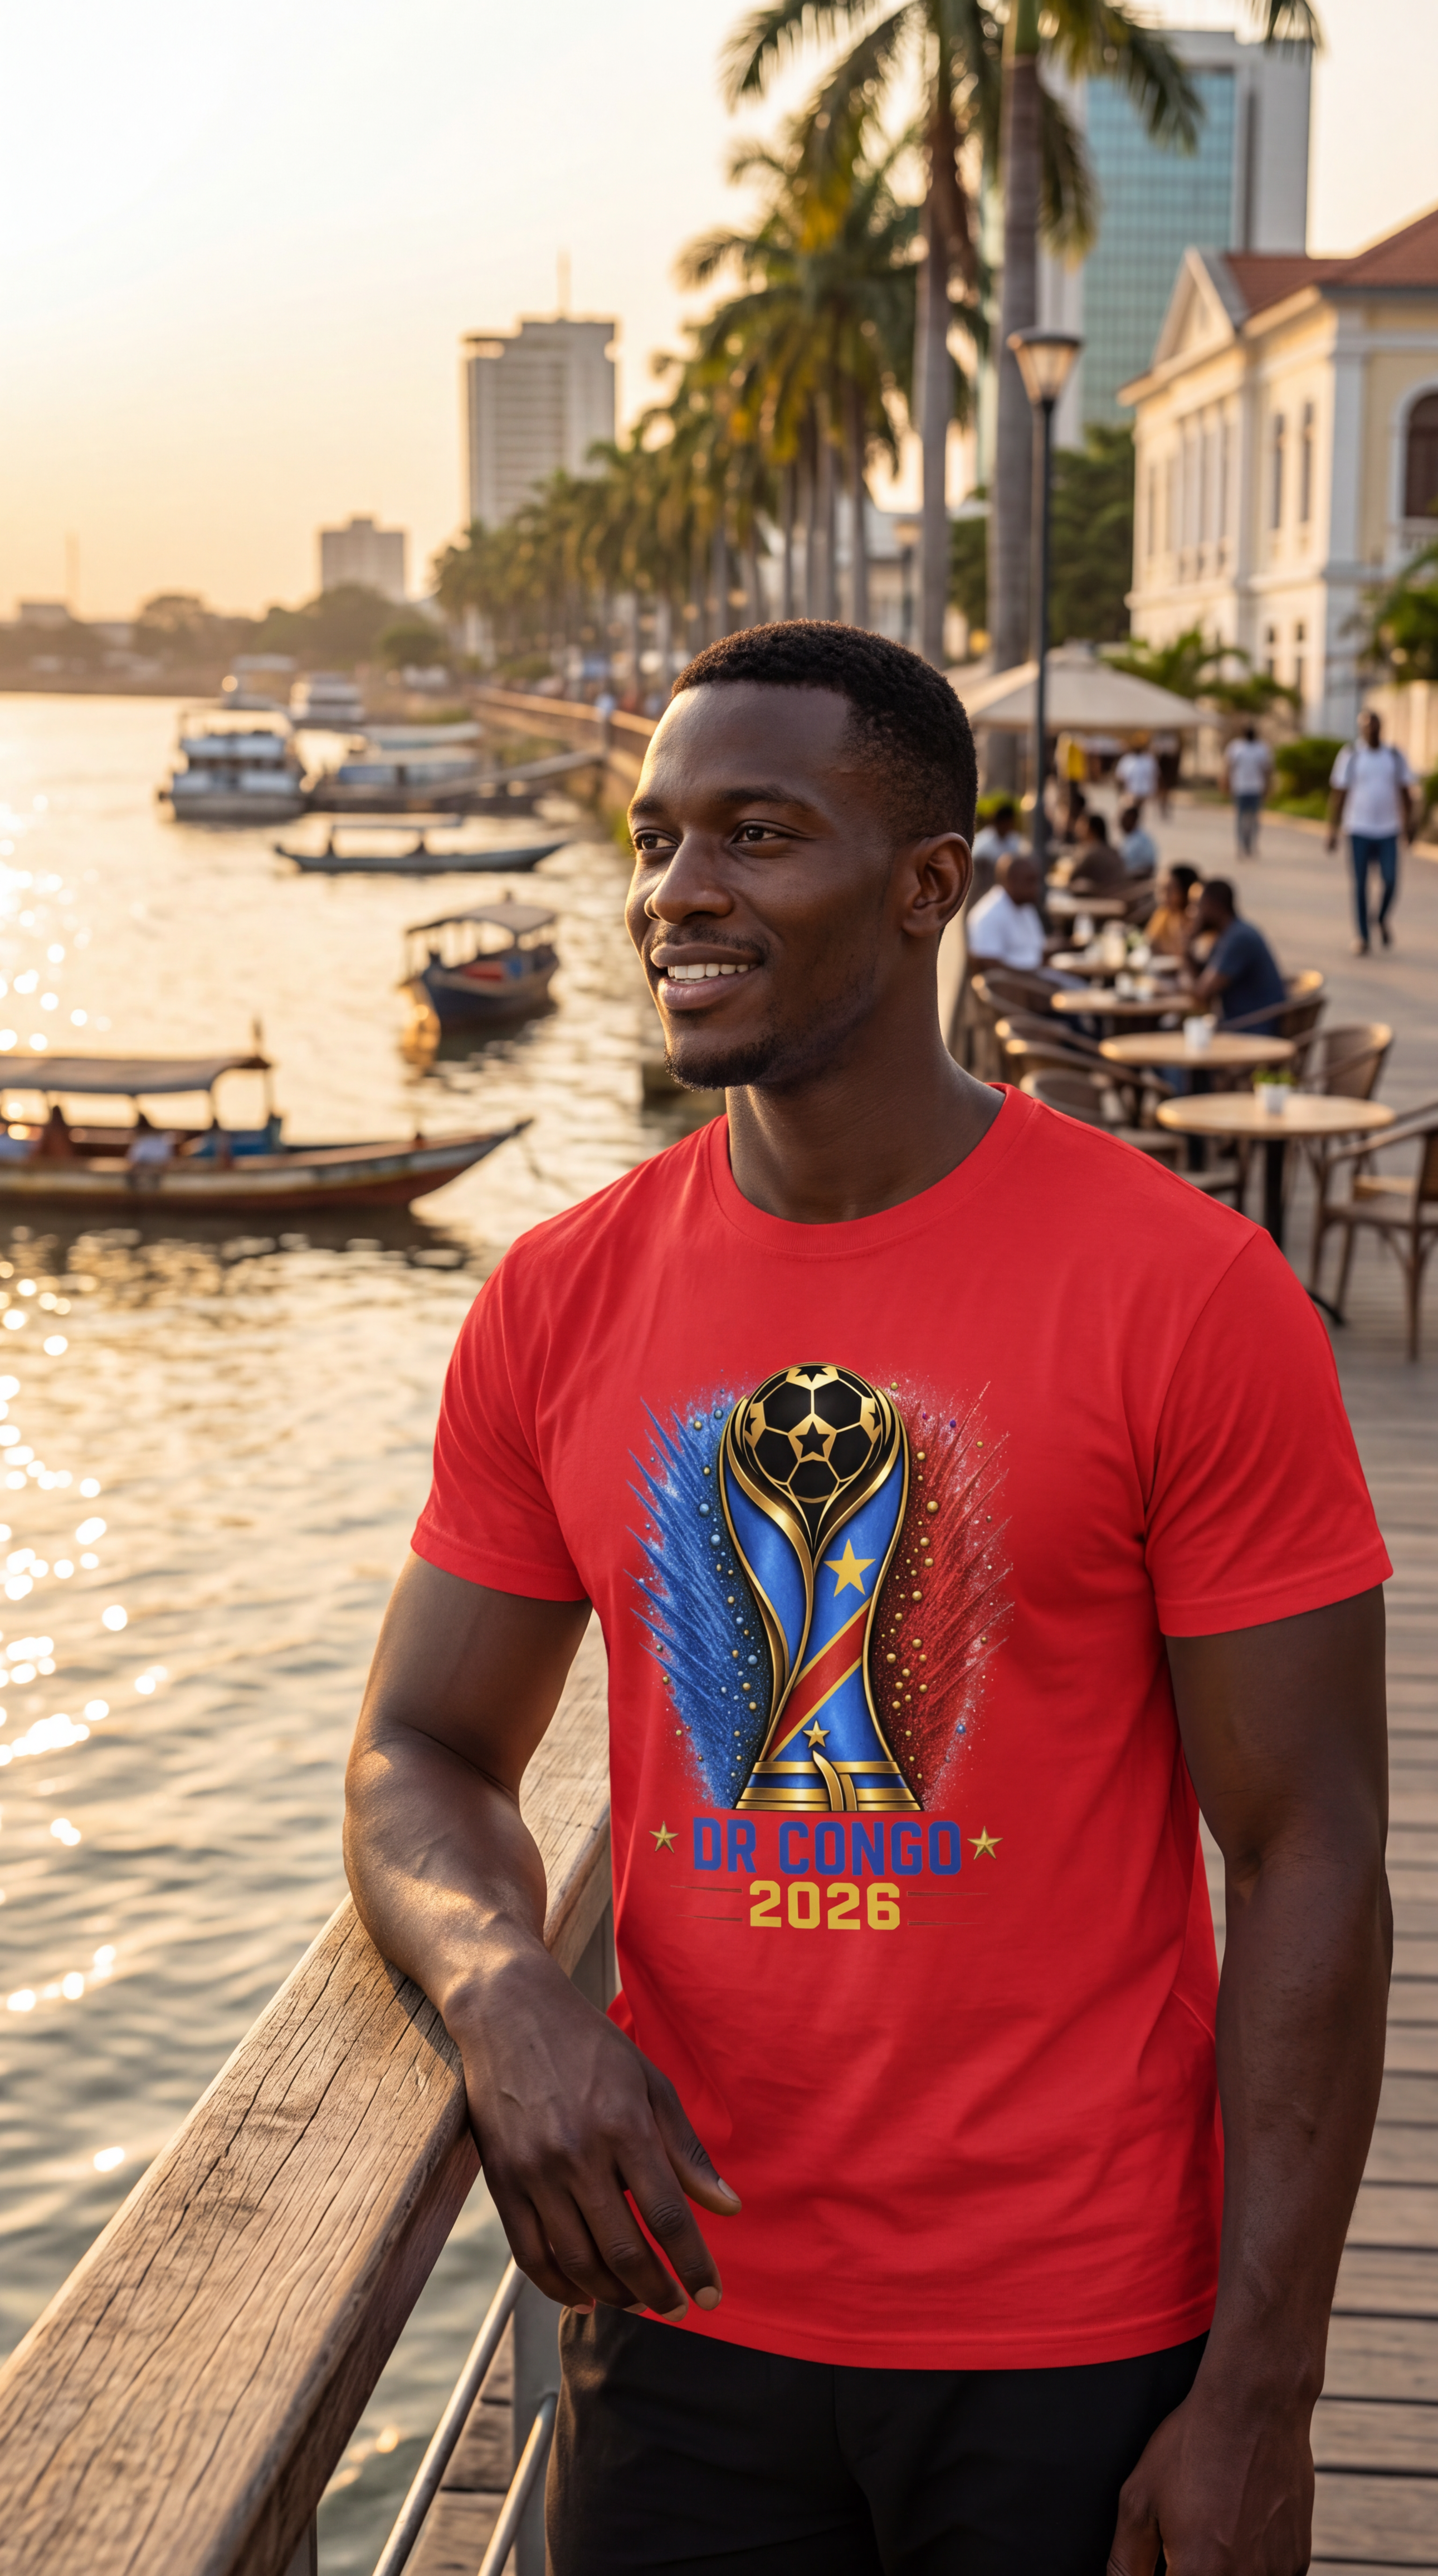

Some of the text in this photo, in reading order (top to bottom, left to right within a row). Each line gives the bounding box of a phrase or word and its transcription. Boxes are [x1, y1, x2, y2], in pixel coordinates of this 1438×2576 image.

[693, 1817, 961, 1876] DR CONGO
[749, 1880, 900, 1930] 2026
